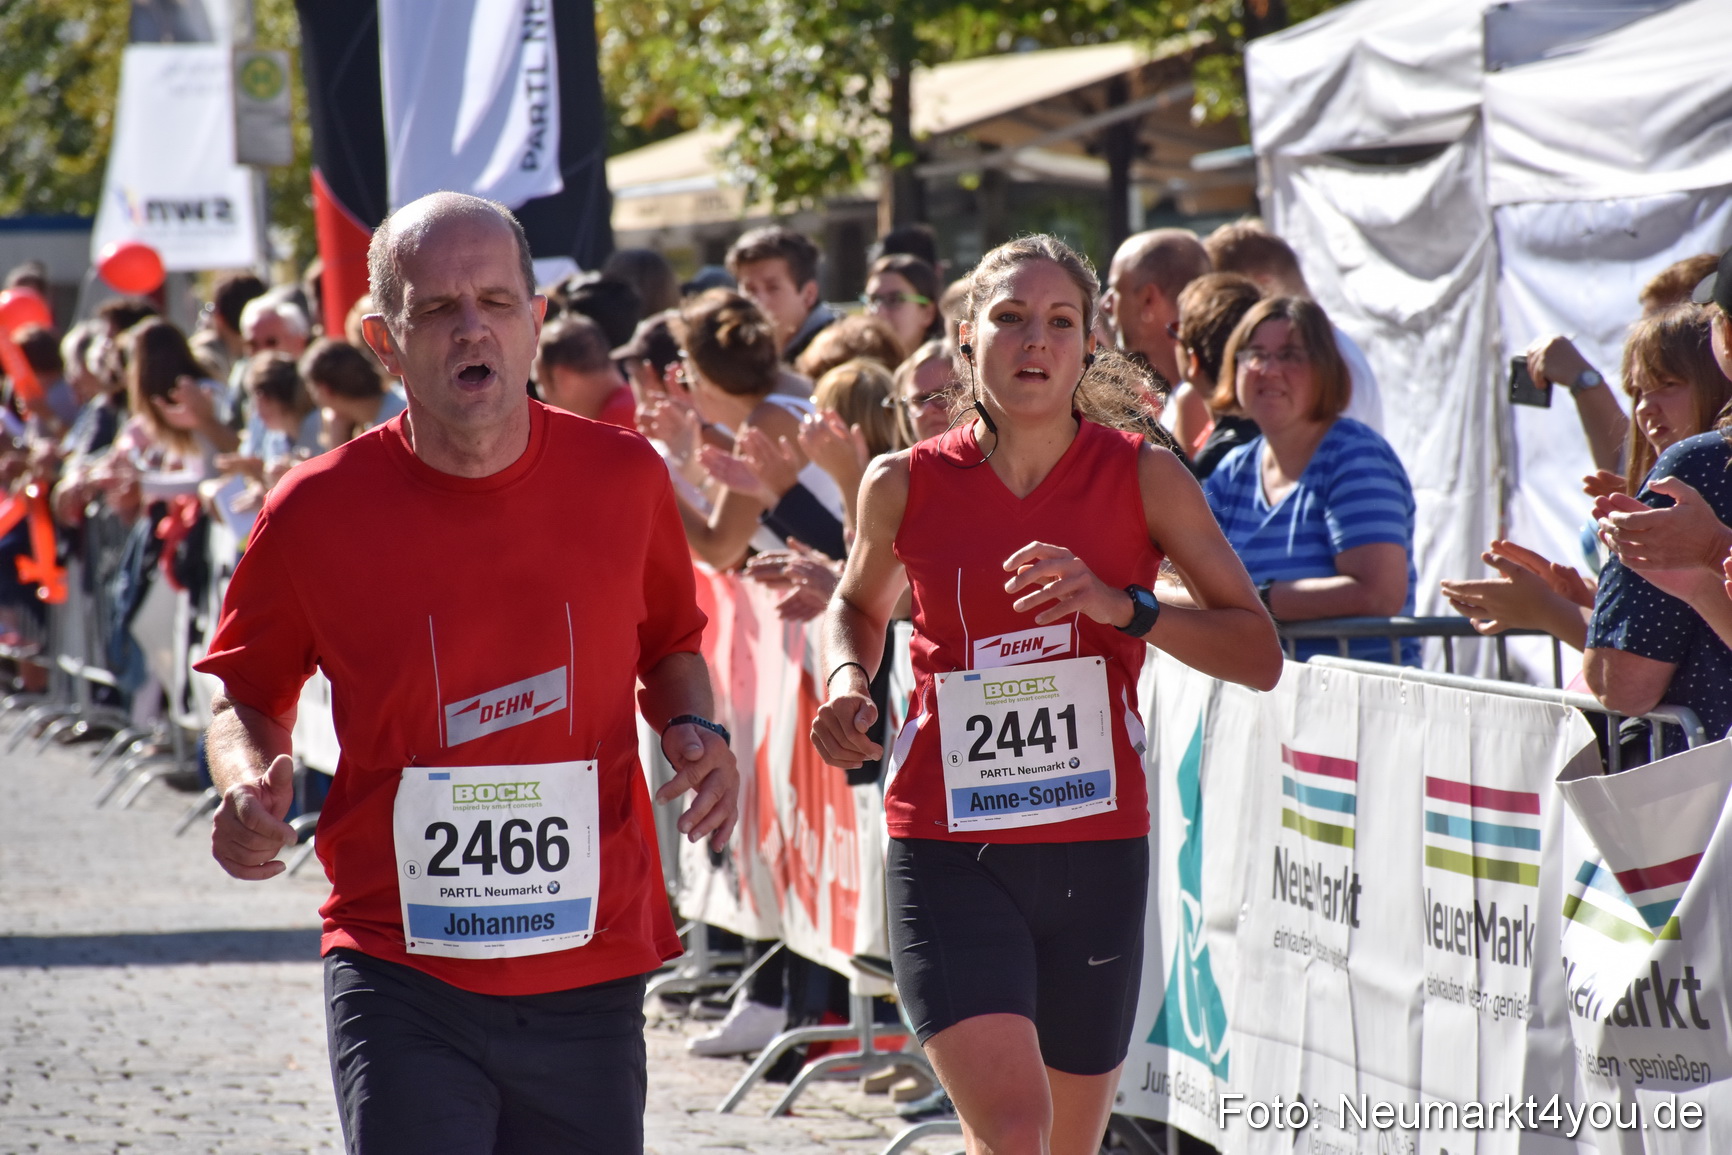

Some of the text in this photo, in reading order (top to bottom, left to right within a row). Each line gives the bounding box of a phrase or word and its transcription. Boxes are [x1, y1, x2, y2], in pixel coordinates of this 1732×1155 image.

[521, 55, 548, 172] PARTL
[1000, 636, 1044, 657] DEHN
[983, 676, 1058, 699] BOCK
[1034, 693, 1060, 701] concepts
[480, 690, 534, 725] DEHN
[966, 703, 1078, 762] 2441
[980, 761, 1065, 779] PARTL Neumarkt
[453, 782, 541, 803] BOCK
[970, 779, 1095, 812] Anne-Sophie
[453, 804, 480, 812] inspired
[424, 816, 570, 876] 2466
[409, 865, 416, 875] B
[440, 884, 542, 898] PARTL Neumarkt
[444, 912, 555, 936] Johannes
[1628, 1053, 1711, 1085] genießen
